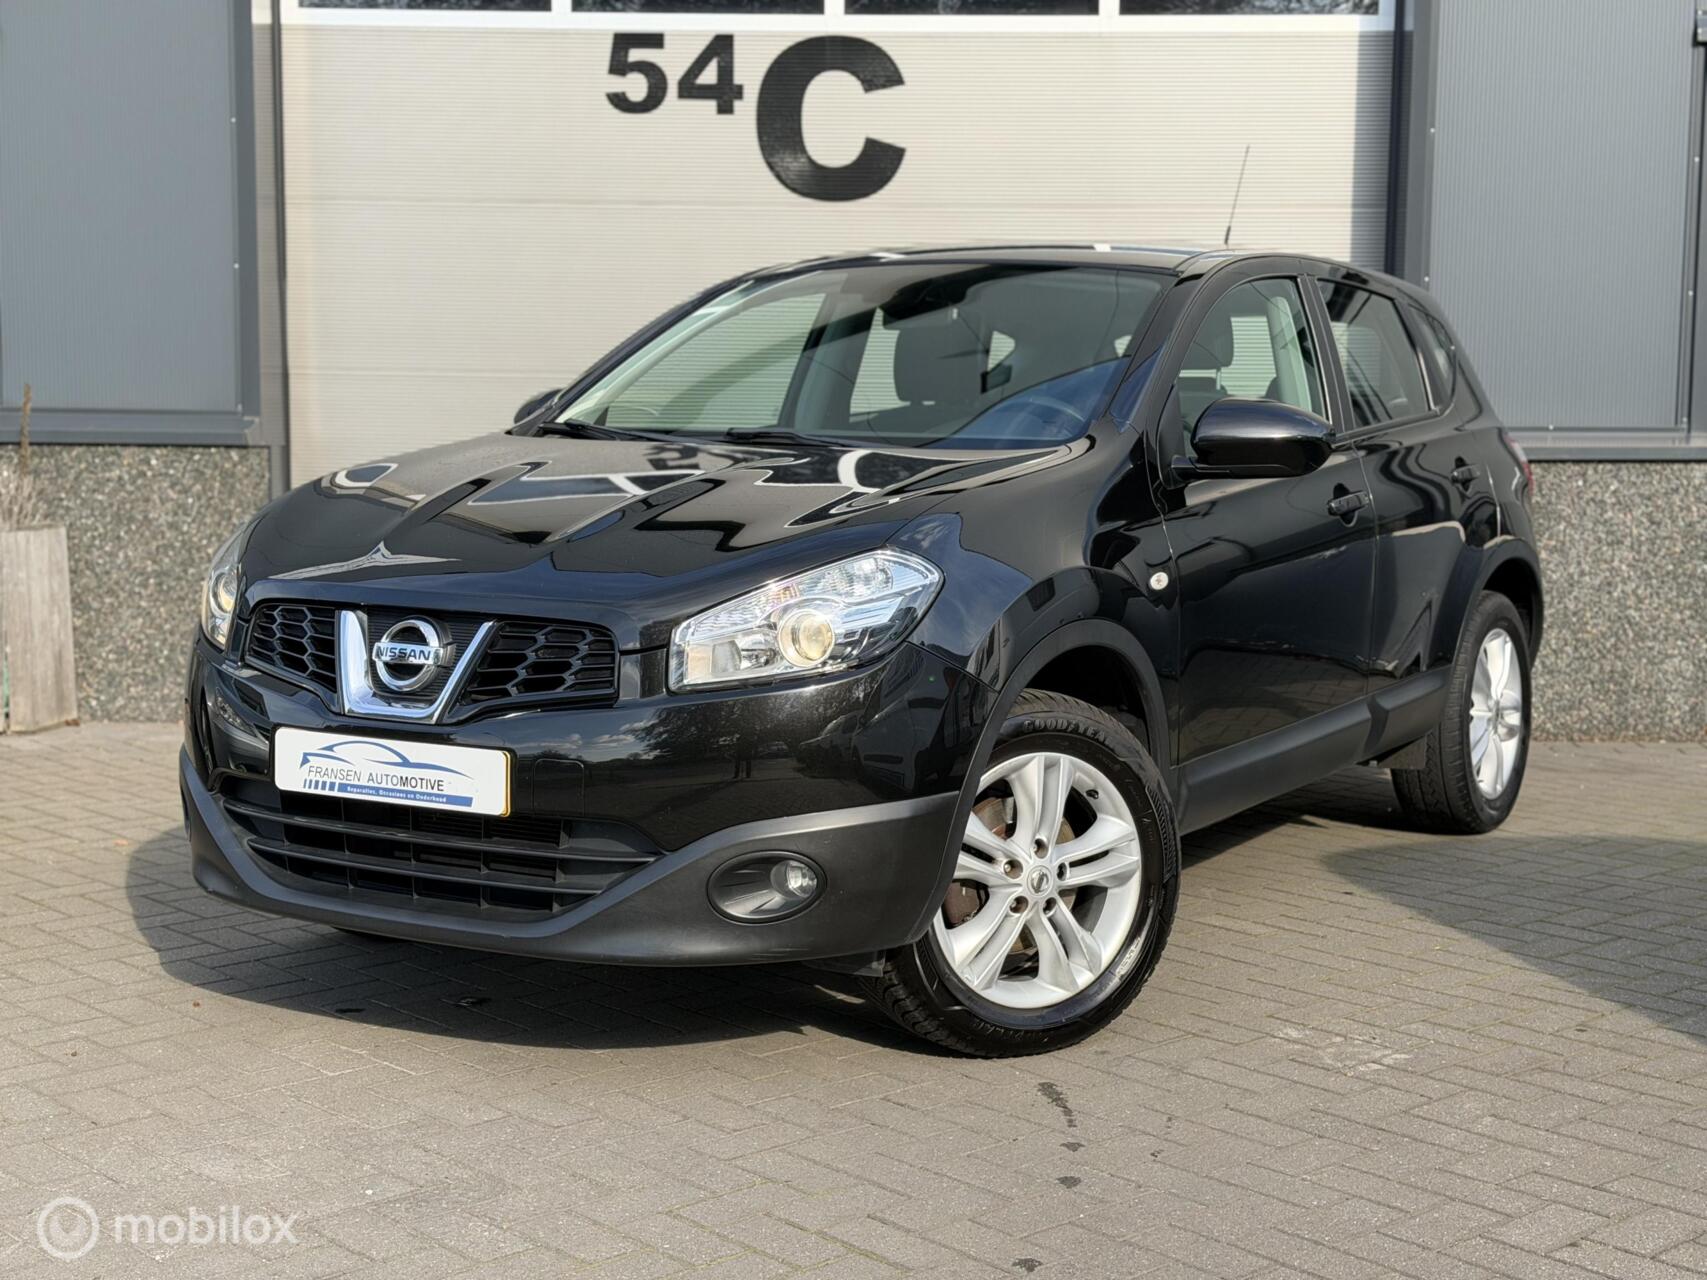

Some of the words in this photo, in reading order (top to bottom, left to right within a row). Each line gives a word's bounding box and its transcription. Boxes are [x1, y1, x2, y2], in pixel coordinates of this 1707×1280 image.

[606, 32, 744, 115] 54
[756, 35, 907, 202] C
[376, 645, 432, 661] NISSAN
[308, 765, 361, 782] FRANSEN
[367, 772, 444, 792] AUTOMOTIVE
